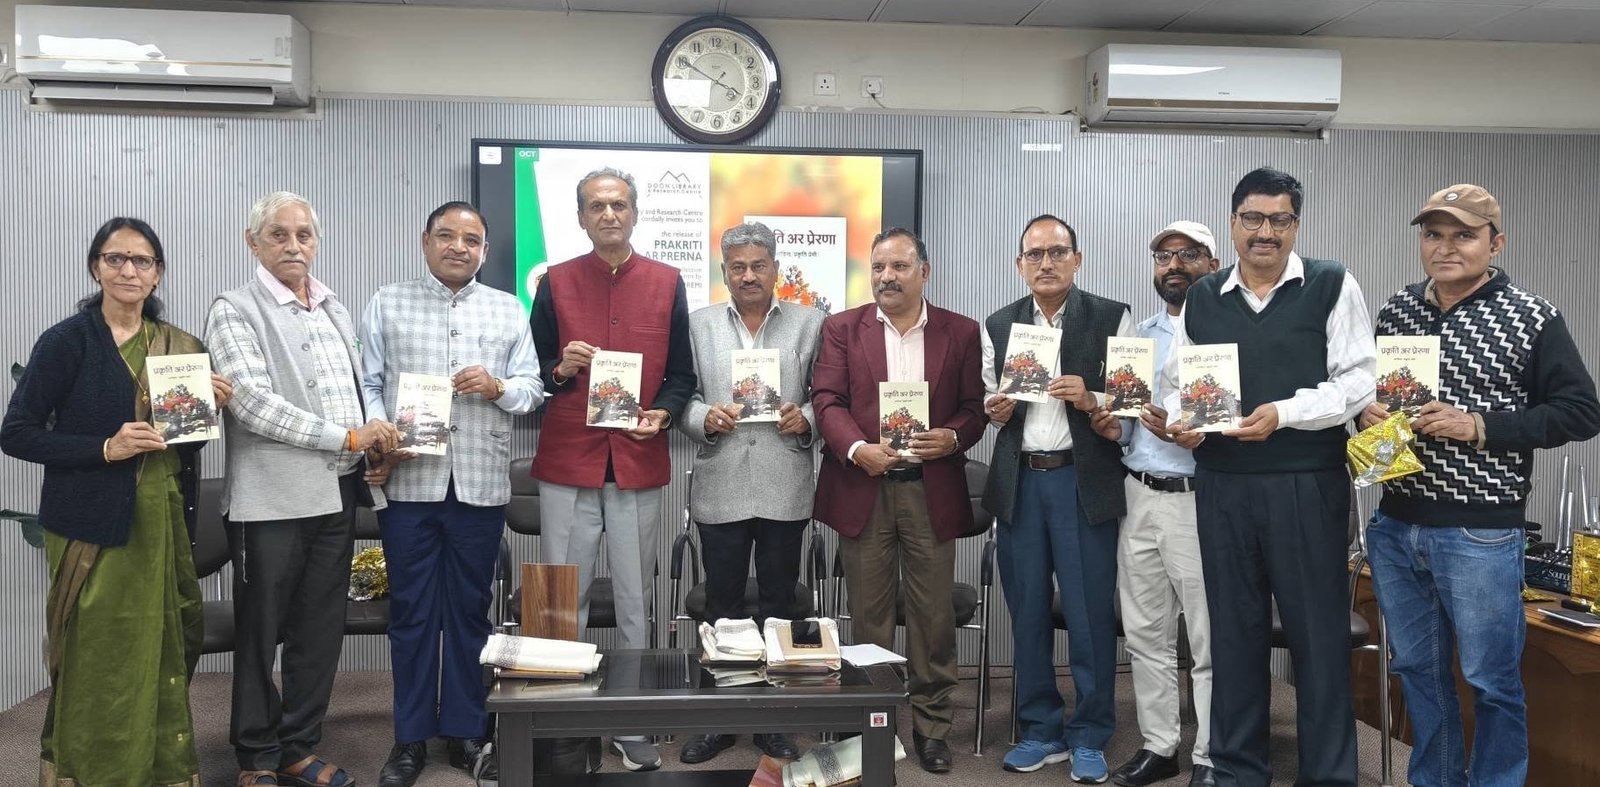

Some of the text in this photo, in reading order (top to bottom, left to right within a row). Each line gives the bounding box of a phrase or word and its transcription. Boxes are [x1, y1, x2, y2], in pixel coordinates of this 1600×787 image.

[693, 42, 700, 52] 11
[712, 38, 722, 47] 12
[679, 56, 688, 66] 10
[746, 57, 754, 68] 2
[752, 77, 760, 88] 3
[746, 98, 754, 108] 4
[693, 110, 700, 122] 7
[733, 112, 740, 123] 5
[714, 116, 721, 128] 6
[788, 234, 804, 244] अर
[806, 230, 836, 246] प्रेरणा
[654, 240, 702, 250] PRAKRITI
[646, 251, 702, 261] AR PRERNA
